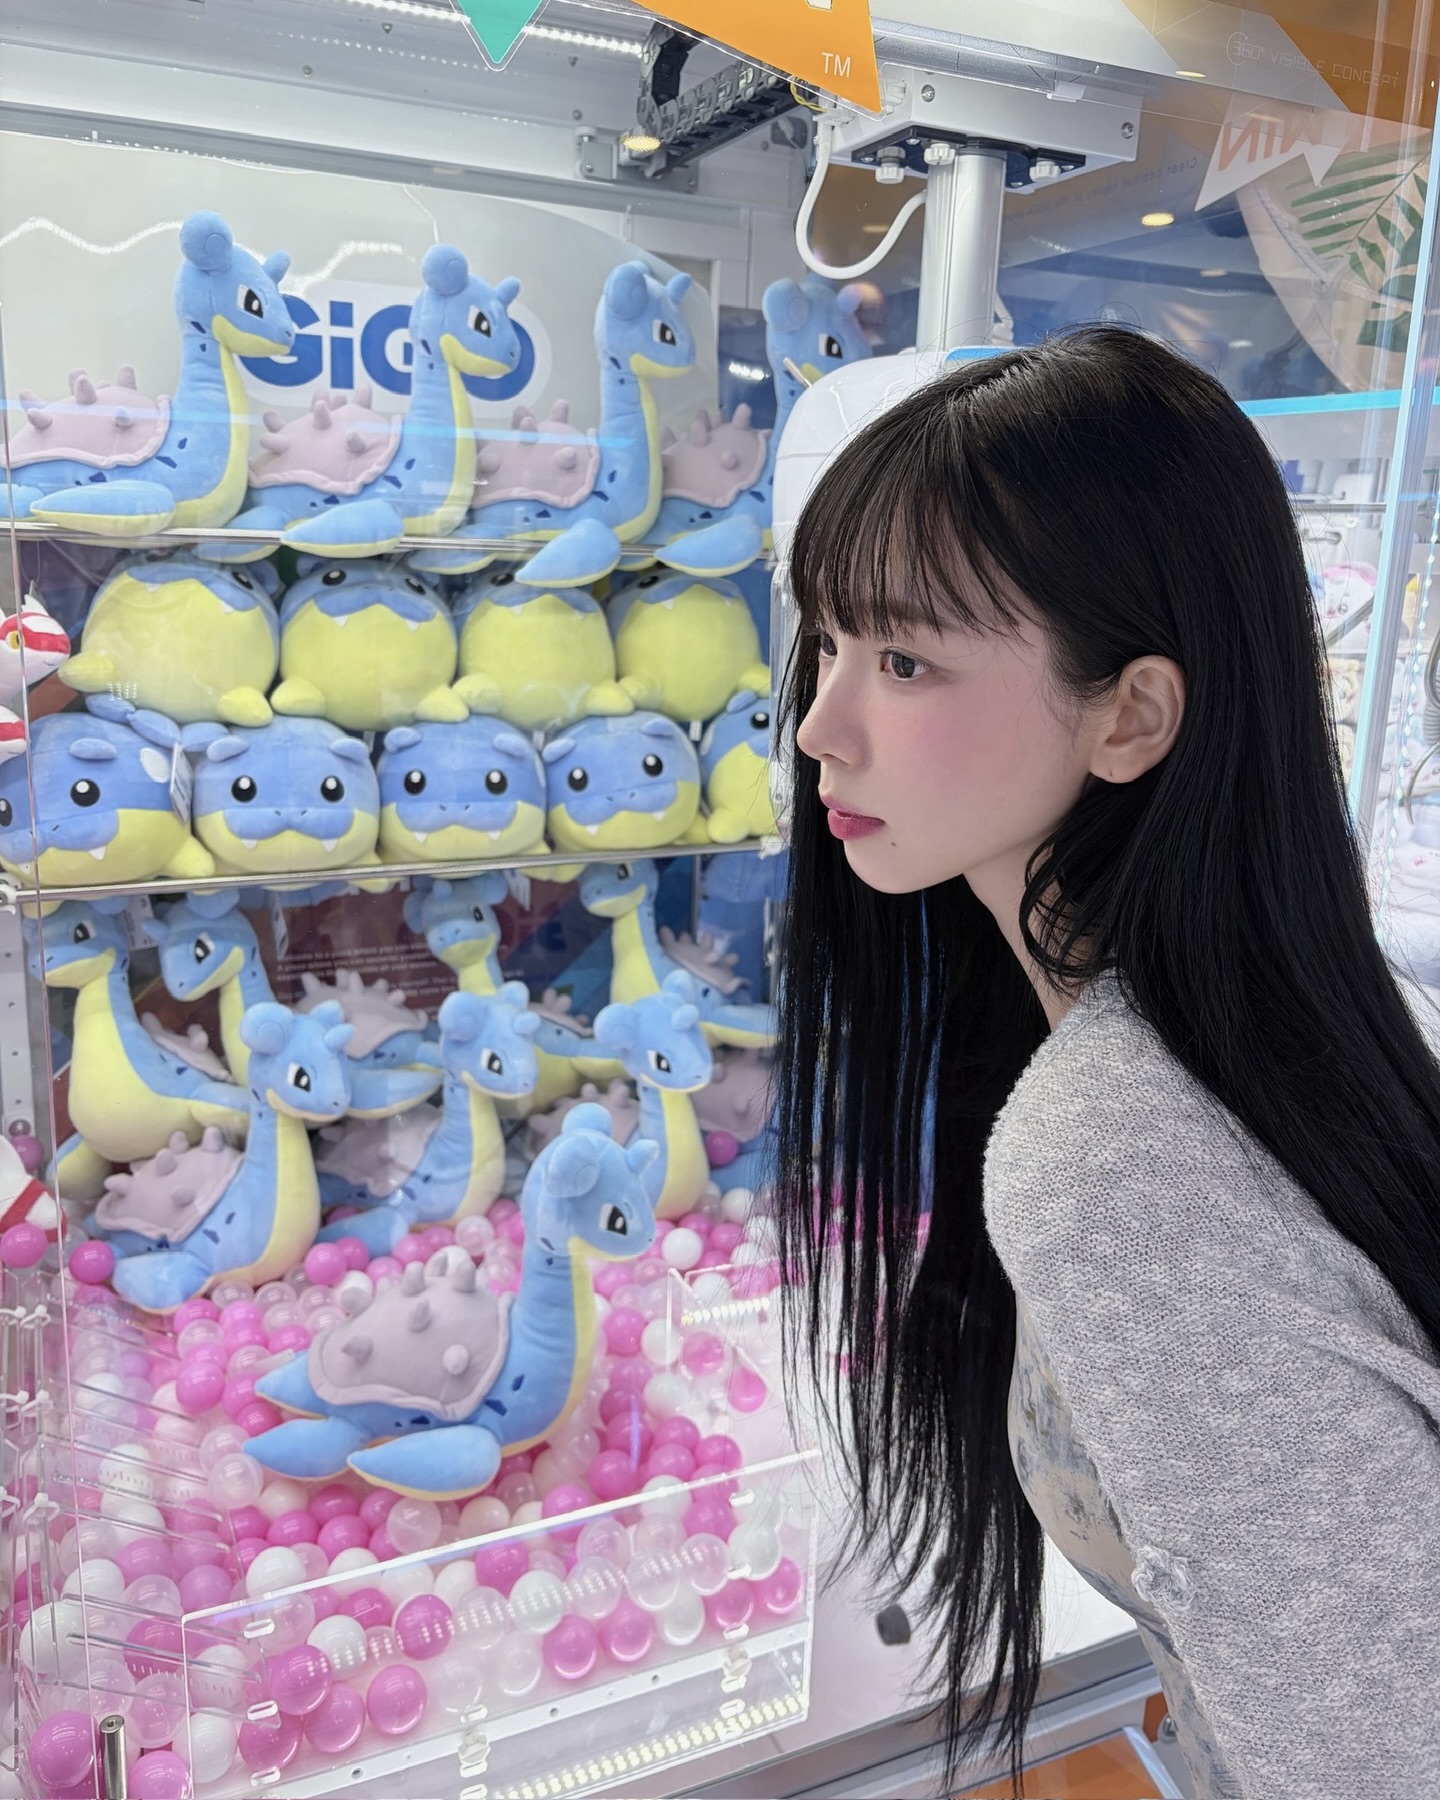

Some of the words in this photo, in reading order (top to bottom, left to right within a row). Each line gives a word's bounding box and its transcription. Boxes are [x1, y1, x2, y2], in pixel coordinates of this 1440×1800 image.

[821, 52, 851, 78] TM
[1270, 48, 1326, 75] VISIBLE
[1332, 63, 1400, 89] CONCEPT
